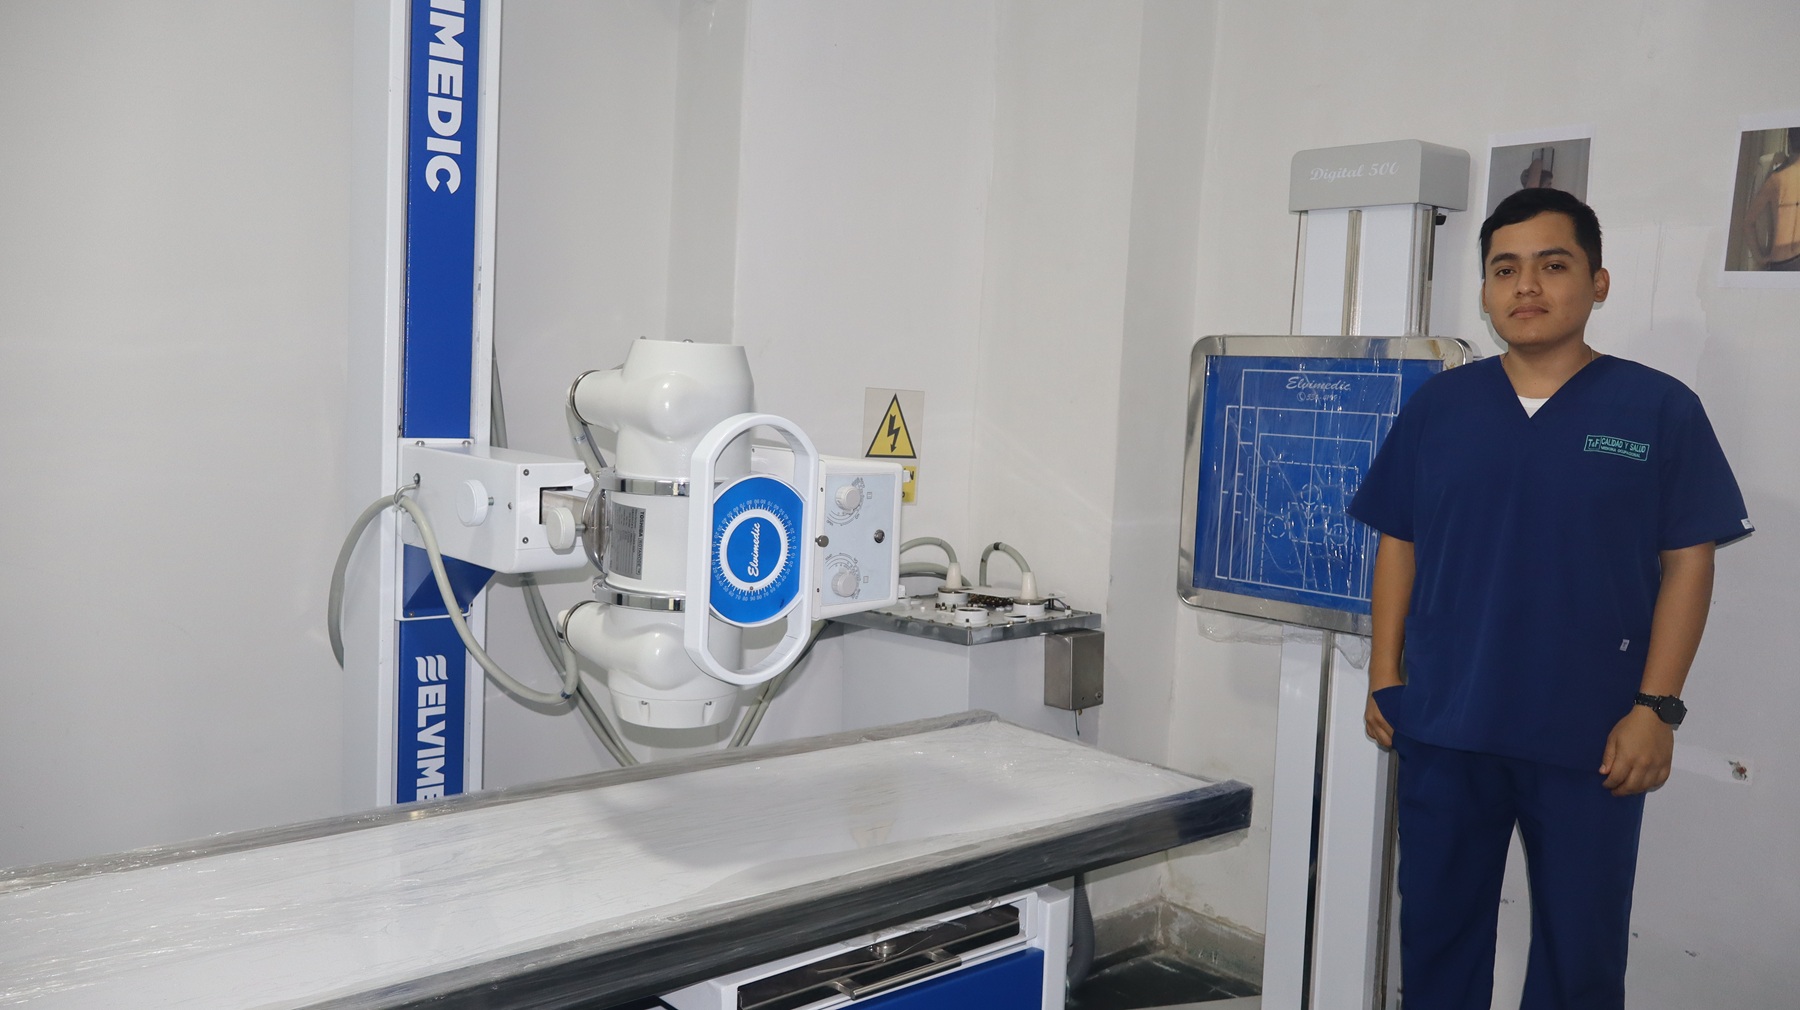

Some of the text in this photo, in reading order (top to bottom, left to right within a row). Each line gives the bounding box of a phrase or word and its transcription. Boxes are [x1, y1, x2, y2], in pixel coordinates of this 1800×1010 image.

[1310, 164, 1365, 183] Digital
[1285, 376, 1351, 391] Elvimedic
[1601, 438, 1623, 448] CALIDAD
[1630, 444, 1646, 453] SALUD
[747, 522, 760, 577] Elvimedic
